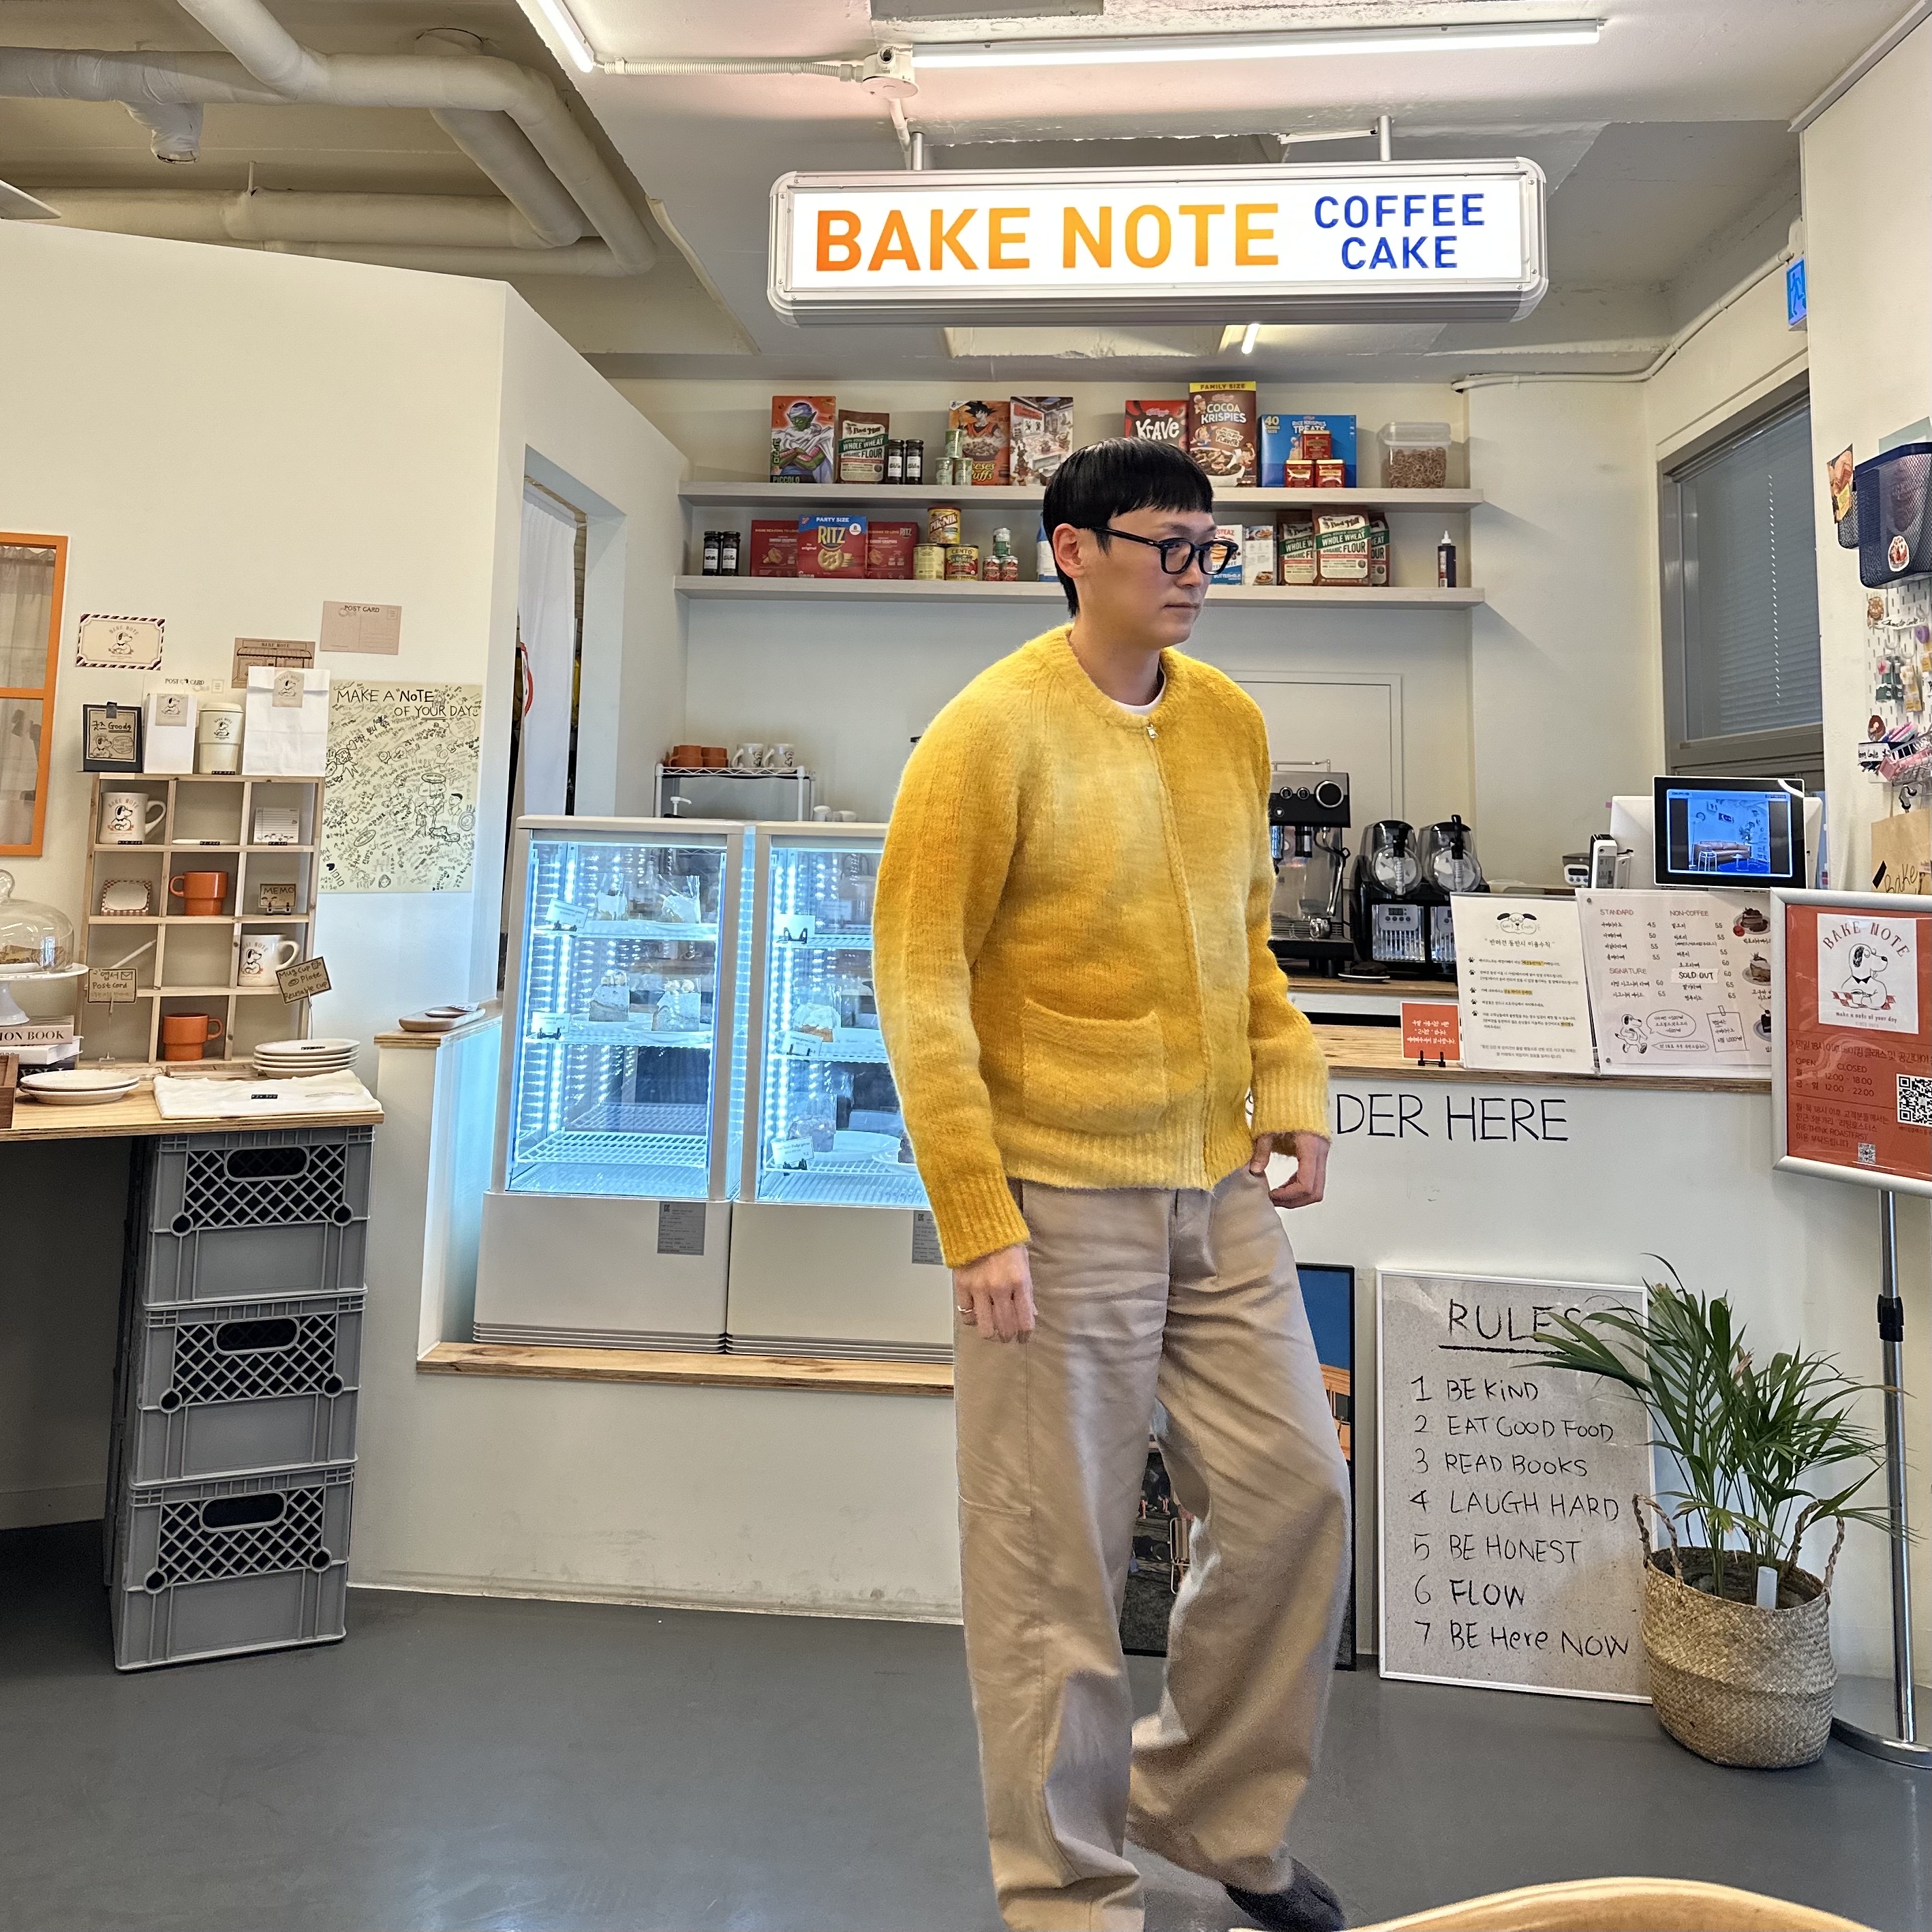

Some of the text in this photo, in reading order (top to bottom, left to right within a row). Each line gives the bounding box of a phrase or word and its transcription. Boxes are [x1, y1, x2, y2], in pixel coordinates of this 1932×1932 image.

[1313, 193, 1486, 230] COFFEE
[816, 202, 1280, 272] BAKE NOTE
[1340, 234, 1458, 270] CAKE
[1206, 403, 1240, 414] COCOA
[1201, 413, 1246, 424] KRISPIES
[1264, 416, 1279, 425] 40
[843, 442, 863, 451] WHOLE
[863, 438, 884, 448] WHEAT
[861, 448, 883, 459] FLOUR
[818, 525, 846, 544] RITZ
[900, 527, 912, 536] RITZ
[1321, 535, 1343, 546] WHOLE
[1345, 530, 1366, 540] WHEAT
[1371, 536, 1384, 545] EAT
[1285, 541, 1306, 553] WHOLE
[1343, 541, 1366, 553] FLOUR
[1371, 547, 1384, 559] OUR
[337, 689, 379, 703] MAKE
[383, 690, 395, 702] A
[394, 705, 474, 716] OF YOUR DAY
[108, 721, 132, 731] Goods
[263, 887, 294, 895] MEMO
[1822, 921, 1910, 957] BAKE NOTE
[100, 972, 119, 981] 엽서
[279, 968, 297, 979] Mug
[301, 972, 322, 983] Plate
[1678, 971, 1714, 980] SOLD OUT
[283, 985, 315, 1001] Reusable
[27, 1030, 64, 1040] BOOK
[1795, 1039, 1810, 1051] 평일
[1865, 1047, 1886, 1059] 클래스
[1796, 1058, 1817, 1067] OPEN
[1837, 1064, 1867, 1073] CLOSED
[1796, 1080, 1803, 1088] 금
[1446, 1095, 1569, 1142] HERE
[1796, 1113, 1809, 1122] 인근
[1796, 1132, 1809, 1143] 이용
[1411, 1376, 1432, 1401] 1
[1447, 1377, 1475, 1400] BE
[1415, 1415, 1614, 1444] 2 EAT GOOD FOOD
[1415, 1448, 1589, 1477] 3 READ BOOKS
[1409, 1490, 1620, 1521] 4 LAUGH HARD
[1413, 1533, 1582, 1565] 5 BE HONEST
[1415, 1574, 1526, 1607] 6 FLOW
[1414, 1621, 1431, 1645] 7
[1450, 1620, 1485, 1651] BE
[1561, 1633, 1629, 1658] NOW
